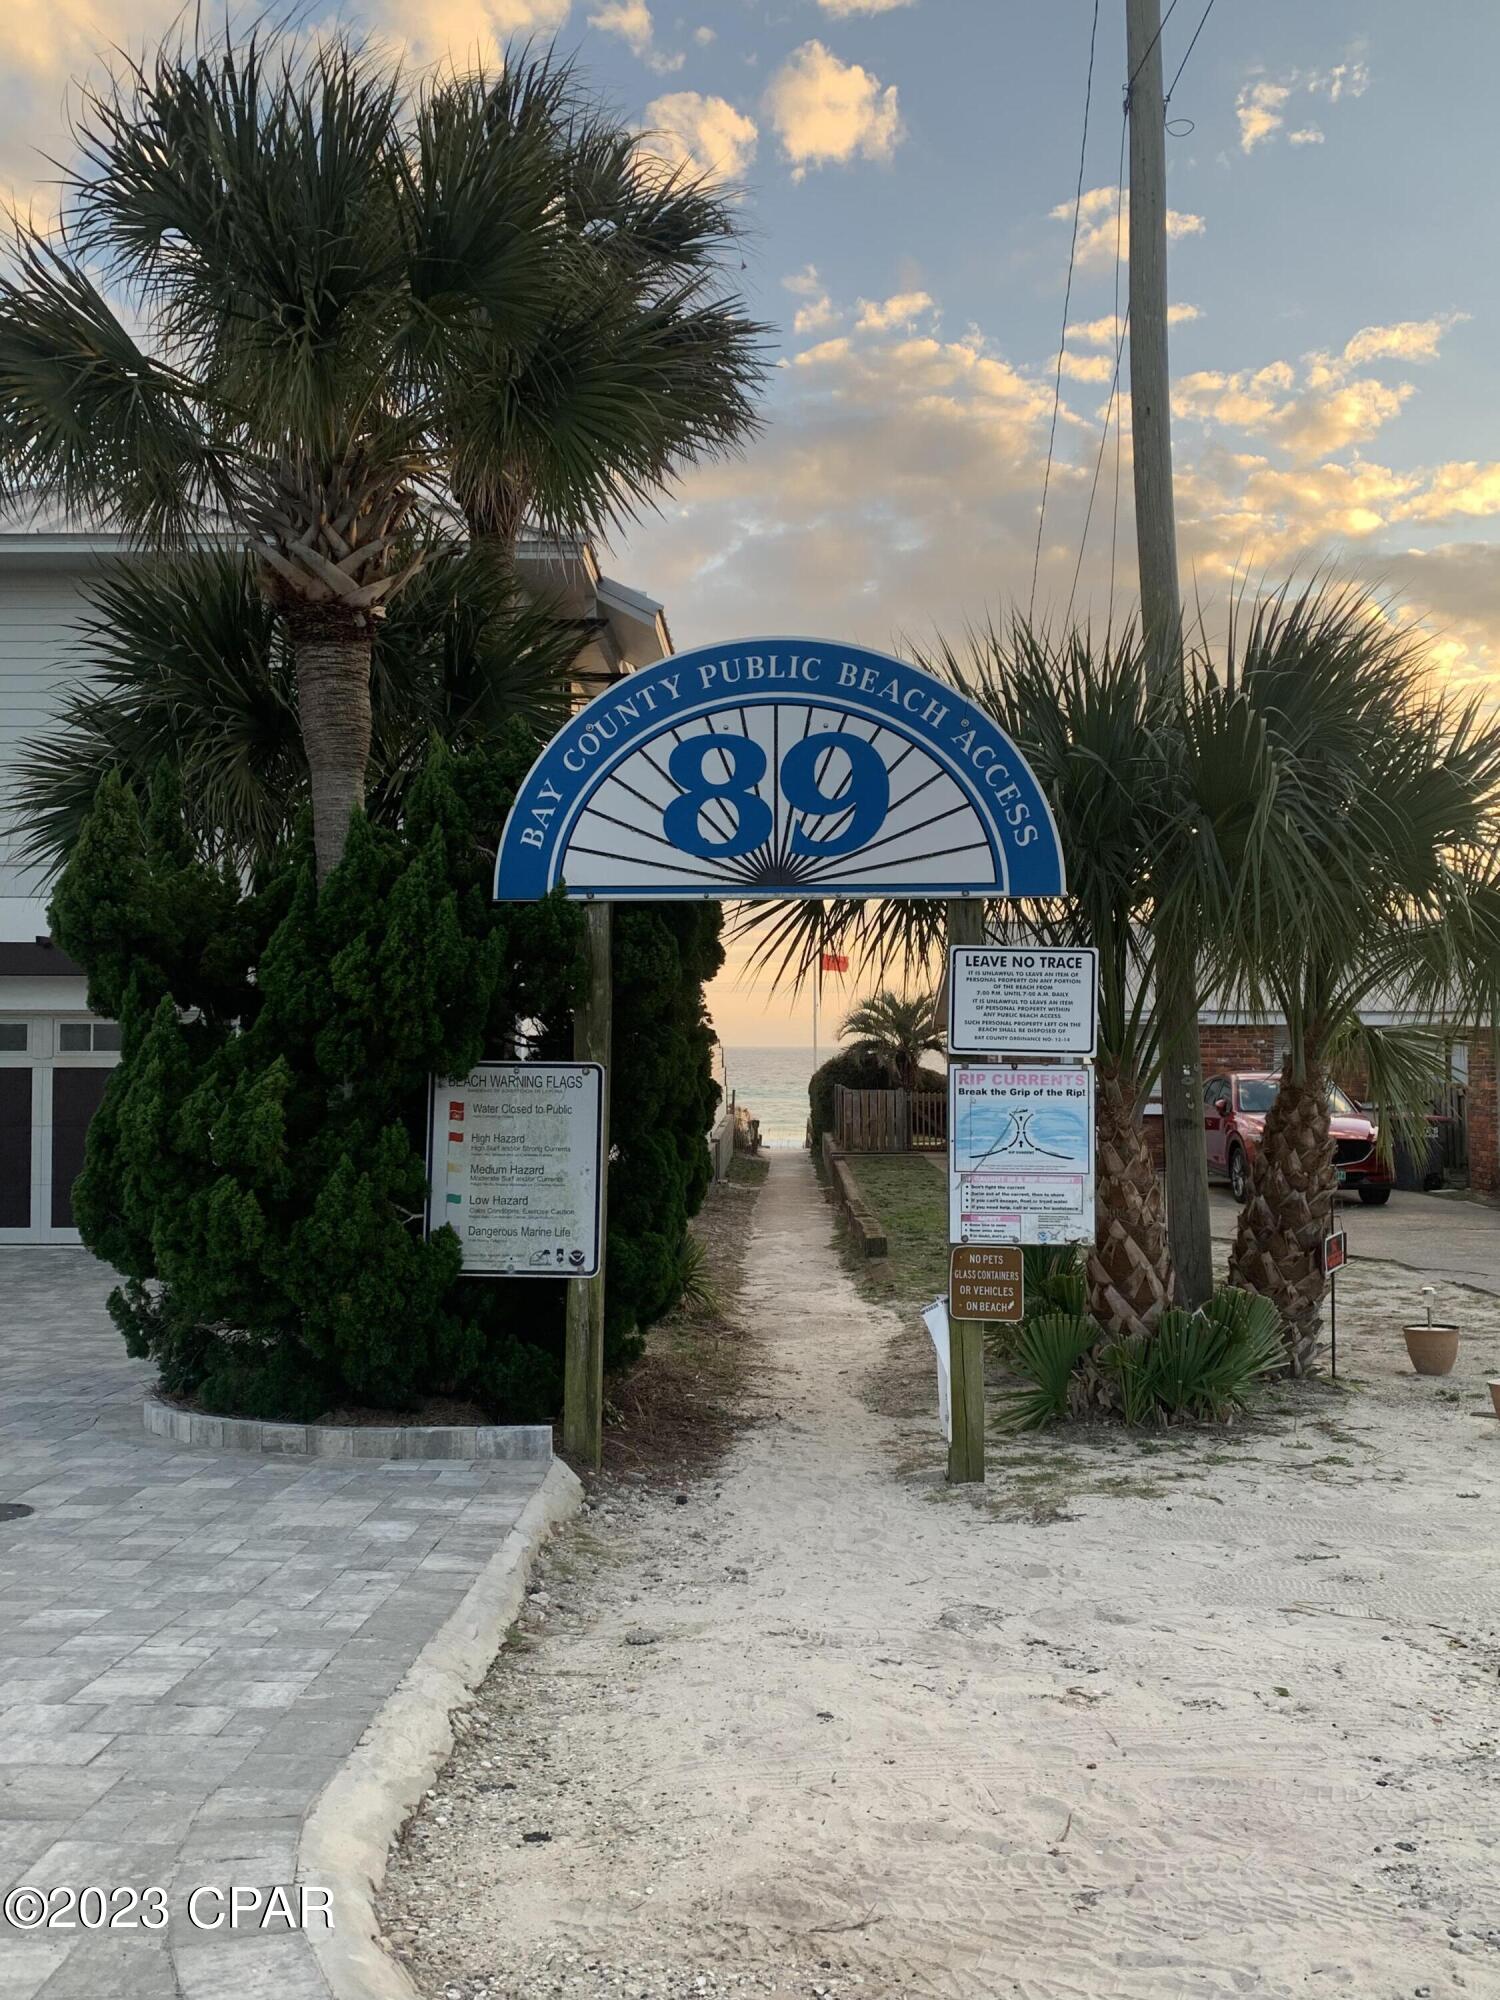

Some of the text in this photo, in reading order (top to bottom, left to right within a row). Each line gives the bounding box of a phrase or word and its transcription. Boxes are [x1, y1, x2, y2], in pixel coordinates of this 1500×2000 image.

[520, 655, 1039, 850] BAY COUNTY PUBLIC BEACH ACCESS
[663, 732, 890, 858] 89
[965, 955, 1083, 969] LEAVE NO TRACE
[448, 1074, 583, 1089] BEACH WARNING FLAGS
[958, 1073, 1086, 1086] RIP CURRENTS
[958, 1088, 1086, 1098] Break the Grip of the Rip!
[473, 1103, 573, 1115] Water Closed to Public
[471, 1133, 525, 1145] High Hazard
[470, 1164, 545, 1175] Medium Hazard
[469, 1195, 528, 1206] Low Hazard
[468, 1225, 571, 1238] Dangerous Marine Life
[969, 1254, 1004, 1265] NO PETS
[954, 1269, 1019, 1281] GLASS CONTAINERS
[960, 1285, 1014, 1296] OR VEHICLES
[966, 1301, 1008, 1312] ON BEACH
